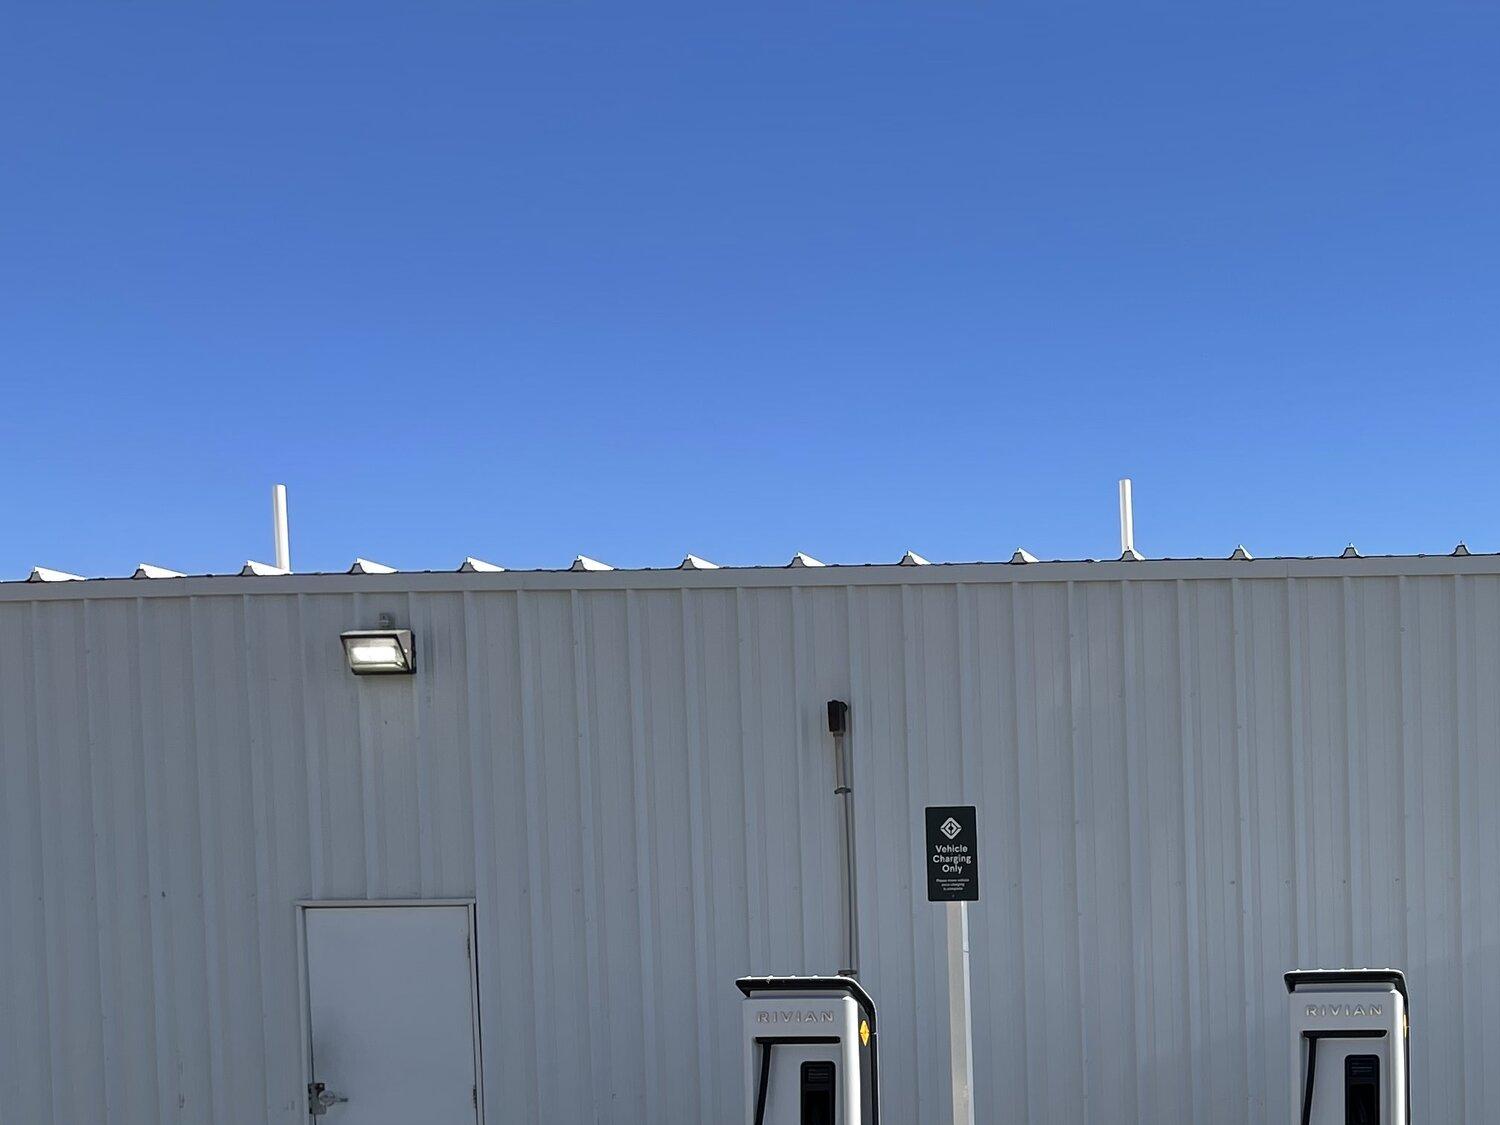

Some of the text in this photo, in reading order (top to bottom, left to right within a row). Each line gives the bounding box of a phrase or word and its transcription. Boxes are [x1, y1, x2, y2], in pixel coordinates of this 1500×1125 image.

[935, 844, 968, 853] Vehicle
[932, 855, 972, 864] Charging
[942, 864, 963, 874] Only
[1305, 1004, 1383, 1016] RIVIAN
[757, 1010, 835, 1023] RIVIAN
